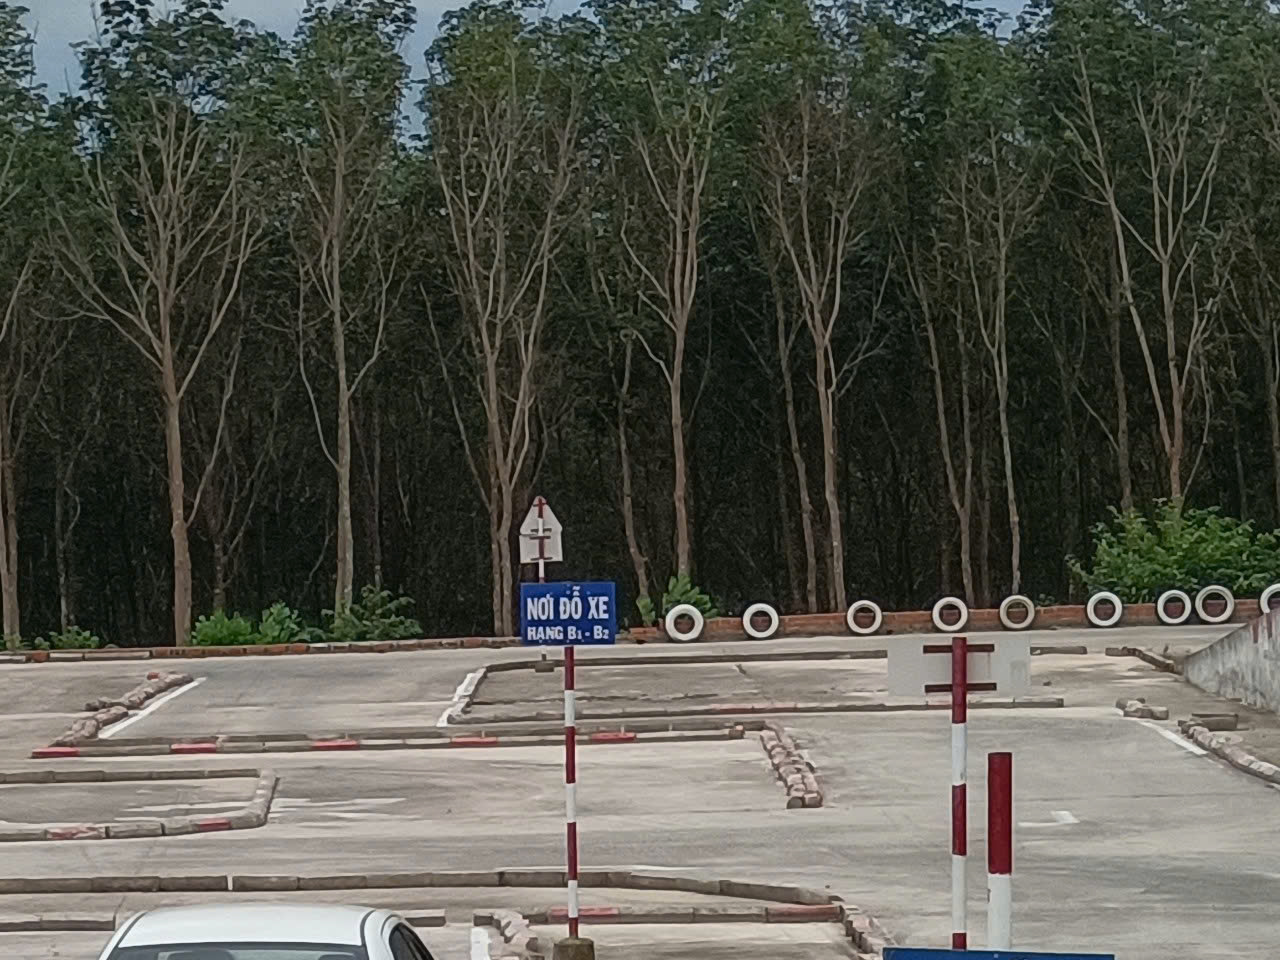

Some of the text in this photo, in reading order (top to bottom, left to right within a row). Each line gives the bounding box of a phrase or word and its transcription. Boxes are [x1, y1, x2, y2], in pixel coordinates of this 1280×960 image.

[527, 585, 609, 620] NƠI ĐỖ XE
[527, 625, 563, 643] HẠNG
[567, 625, 582, 640] B1
[593, 625, 609, 639] B2
